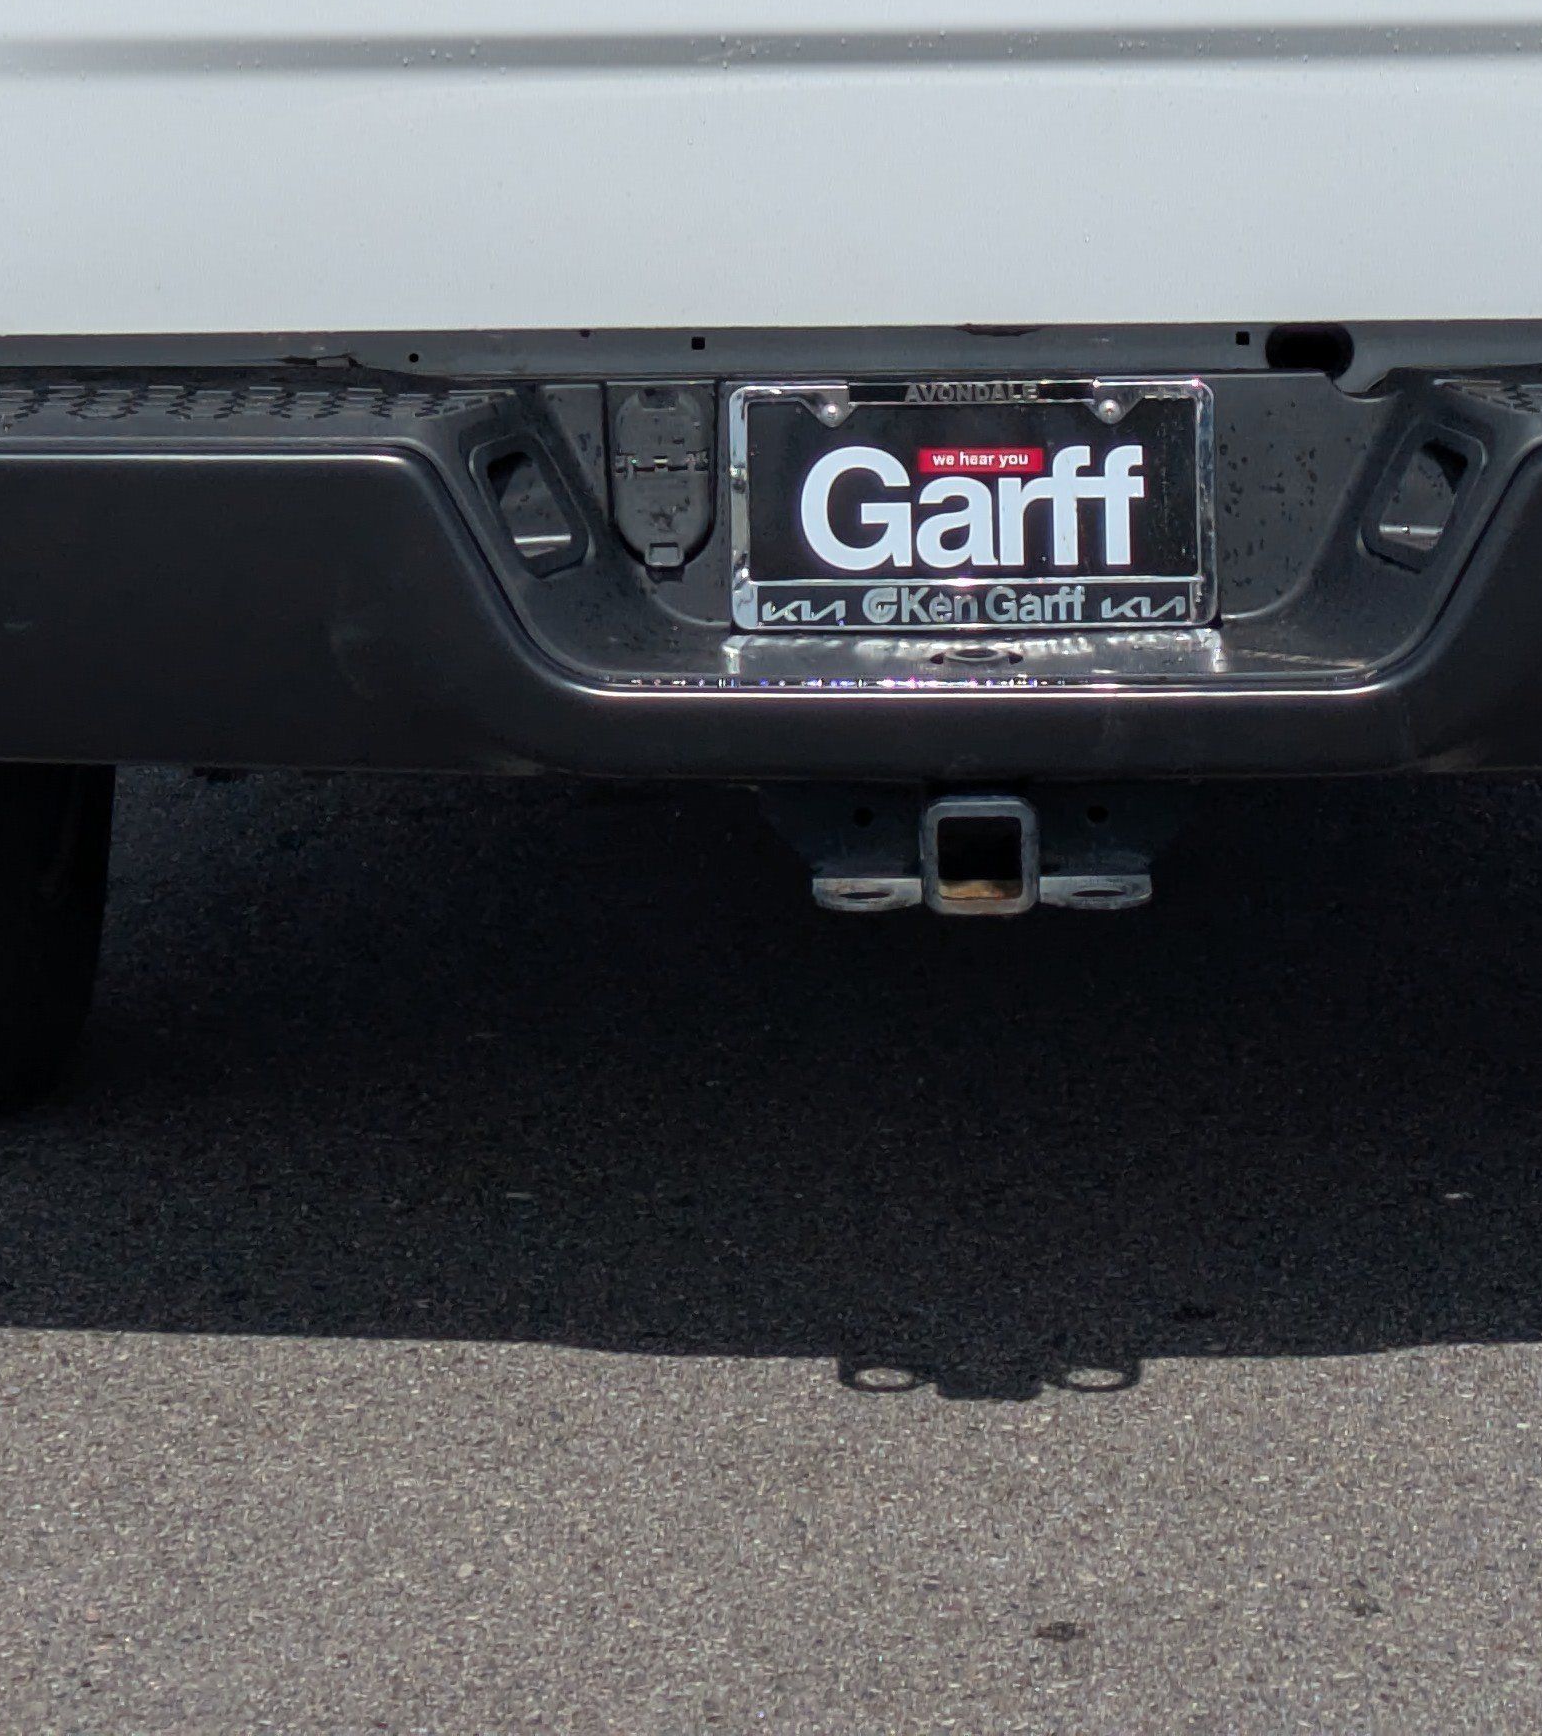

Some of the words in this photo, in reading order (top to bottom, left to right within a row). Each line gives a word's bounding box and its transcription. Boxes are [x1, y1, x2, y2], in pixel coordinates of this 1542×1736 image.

[905, 382, 1039, 402] AVONDALE
[932, 454, 954, 466] we
[959, 451, 995, 466] hear
[999, 454, 1029, 468] you
[800, 445, 1145, 571] Garff
[901, 586, 979, 623] Ken
[984, 585, 1086, 622] Garff
